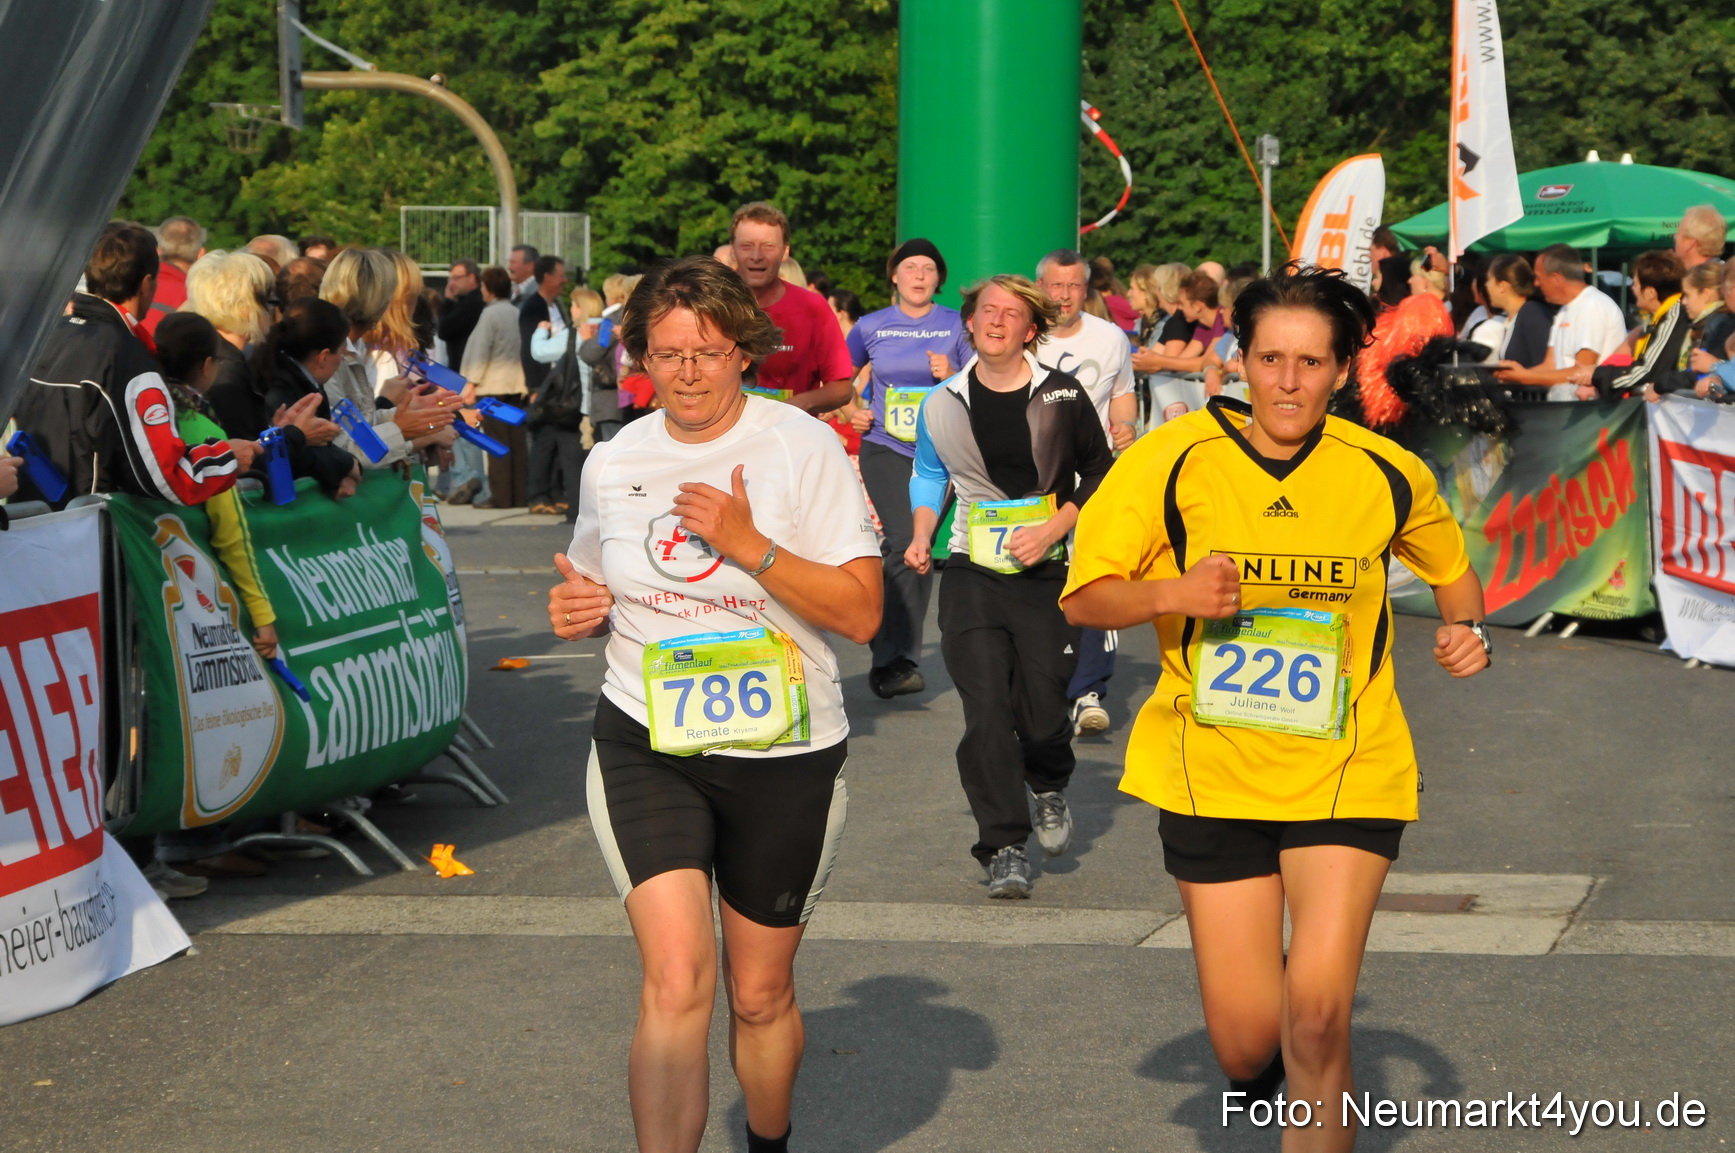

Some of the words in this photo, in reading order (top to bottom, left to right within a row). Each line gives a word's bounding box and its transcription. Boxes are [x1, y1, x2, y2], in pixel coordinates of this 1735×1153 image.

[876, 329, 951, 338] TEPPICHLÄUFER
[1262, 508, 1299, 518] adidas
[265, 522, 419, 626] Neumarkter
[1228, 557, 1344, 583] NLINE
[1288, 588, 1353, 604] Germany
[191, 617, 241, 650] Neumarkter
[1221, 623, 1273, 639] firmenlauf
[186, 646, 264, 693] Lammsbräu
[665, 658, 713, 671] firmenlauf
[1209, 643, 1322, 703] 226
[277, 609, 461, 769] Lammsbräu
[663, 671, 771, 727] 786
[1230, 696, 1277, 712] Juliane
[1280, 706, 1296, 714] Wolf
[686, 727, 730, 740] Renate
